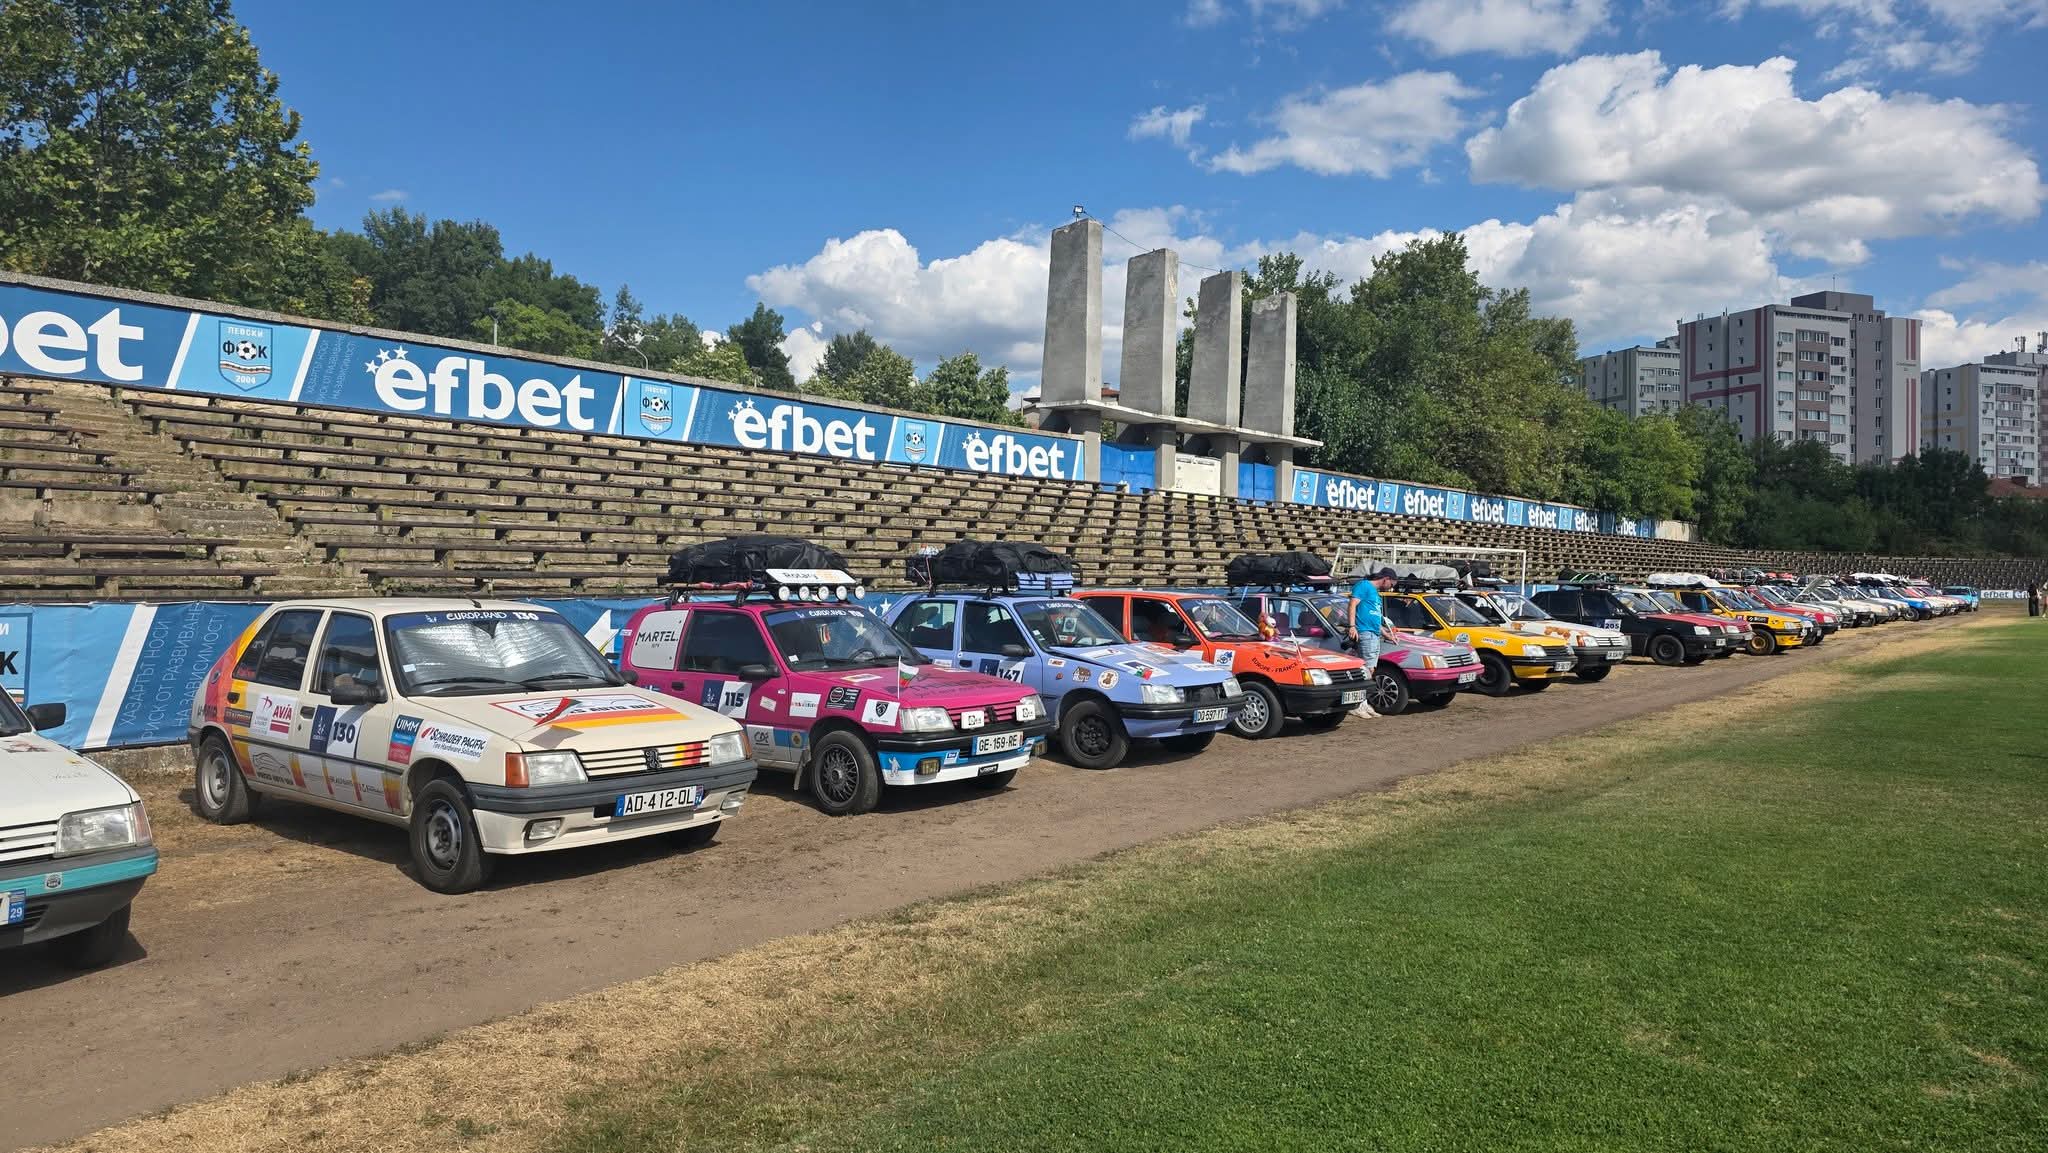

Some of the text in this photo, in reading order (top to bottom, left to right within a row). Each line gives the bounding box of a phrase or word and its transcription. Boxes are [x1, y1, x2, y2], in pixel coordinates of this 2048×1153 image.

[0, 308, 144, 381] et
[235, 376, 256, 385] 2004
[374, 356, 595, 431] efbet
[734, 405, 876, 460] efbet
[966, 435, 1064, 478] efbet
[1328, 480, 1375, 511] efbet
[1405, 489, 1444, 516] efbet
[1472, 500, 1505, 523] efbet
[1529, 507, 1557, 529] efbet
[512, 611, 540, 620] 130
[119, 620, 173, 726] ХАЗАРТЪТ НОСИ
[999, 668, 1021, 682] 147
[1252, 657, 1270, 672] EUROPE
[725, 692, 744, 707] 115
[141, 703, 168, 740] РИСК
[156, 685, 175, 702] ОТ
[174, 709, 190, 727] НА
[333, 722, 355, 743] 130
[396, 718, 420, 732] UIMM
[461, 747, 481, 757] Solutions
[10, 907, 23, 919] 29
